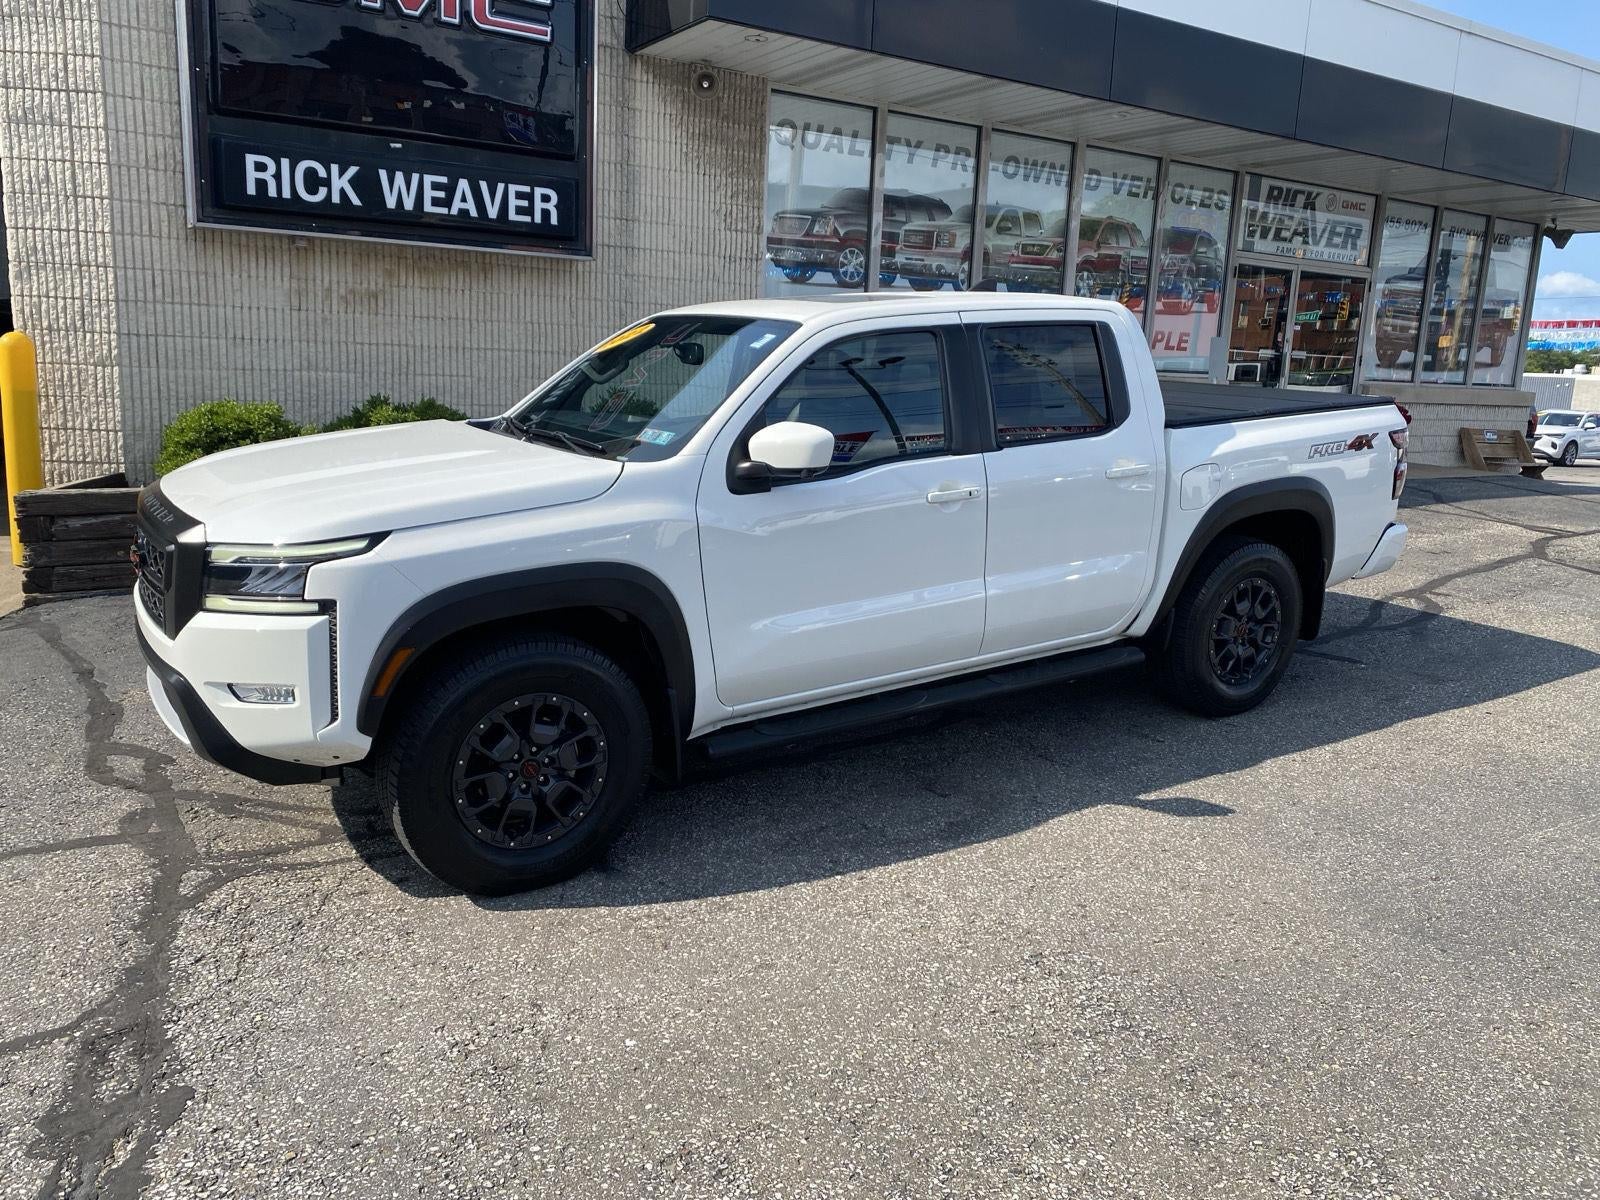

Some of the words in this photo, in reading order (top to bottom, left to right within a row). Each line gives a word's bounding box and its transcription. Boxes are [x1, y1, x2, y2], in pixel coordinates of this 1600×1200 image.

[775, 118, 924, 164] QUALTY
[1112, 171, 1229, 211] VEHCLES
[244, 153, 363, 207] RICK
[378, 168, 559, 226] WEAVER
[1266, 184, 1323, 211] RICK
[1341, 200, 1367, 212] GMC
[1246, 207, 1363, 250] WEAVER
[1310, 250, 1324, 259] FOR
[1327, 251, 1358, 263] SERVICE
